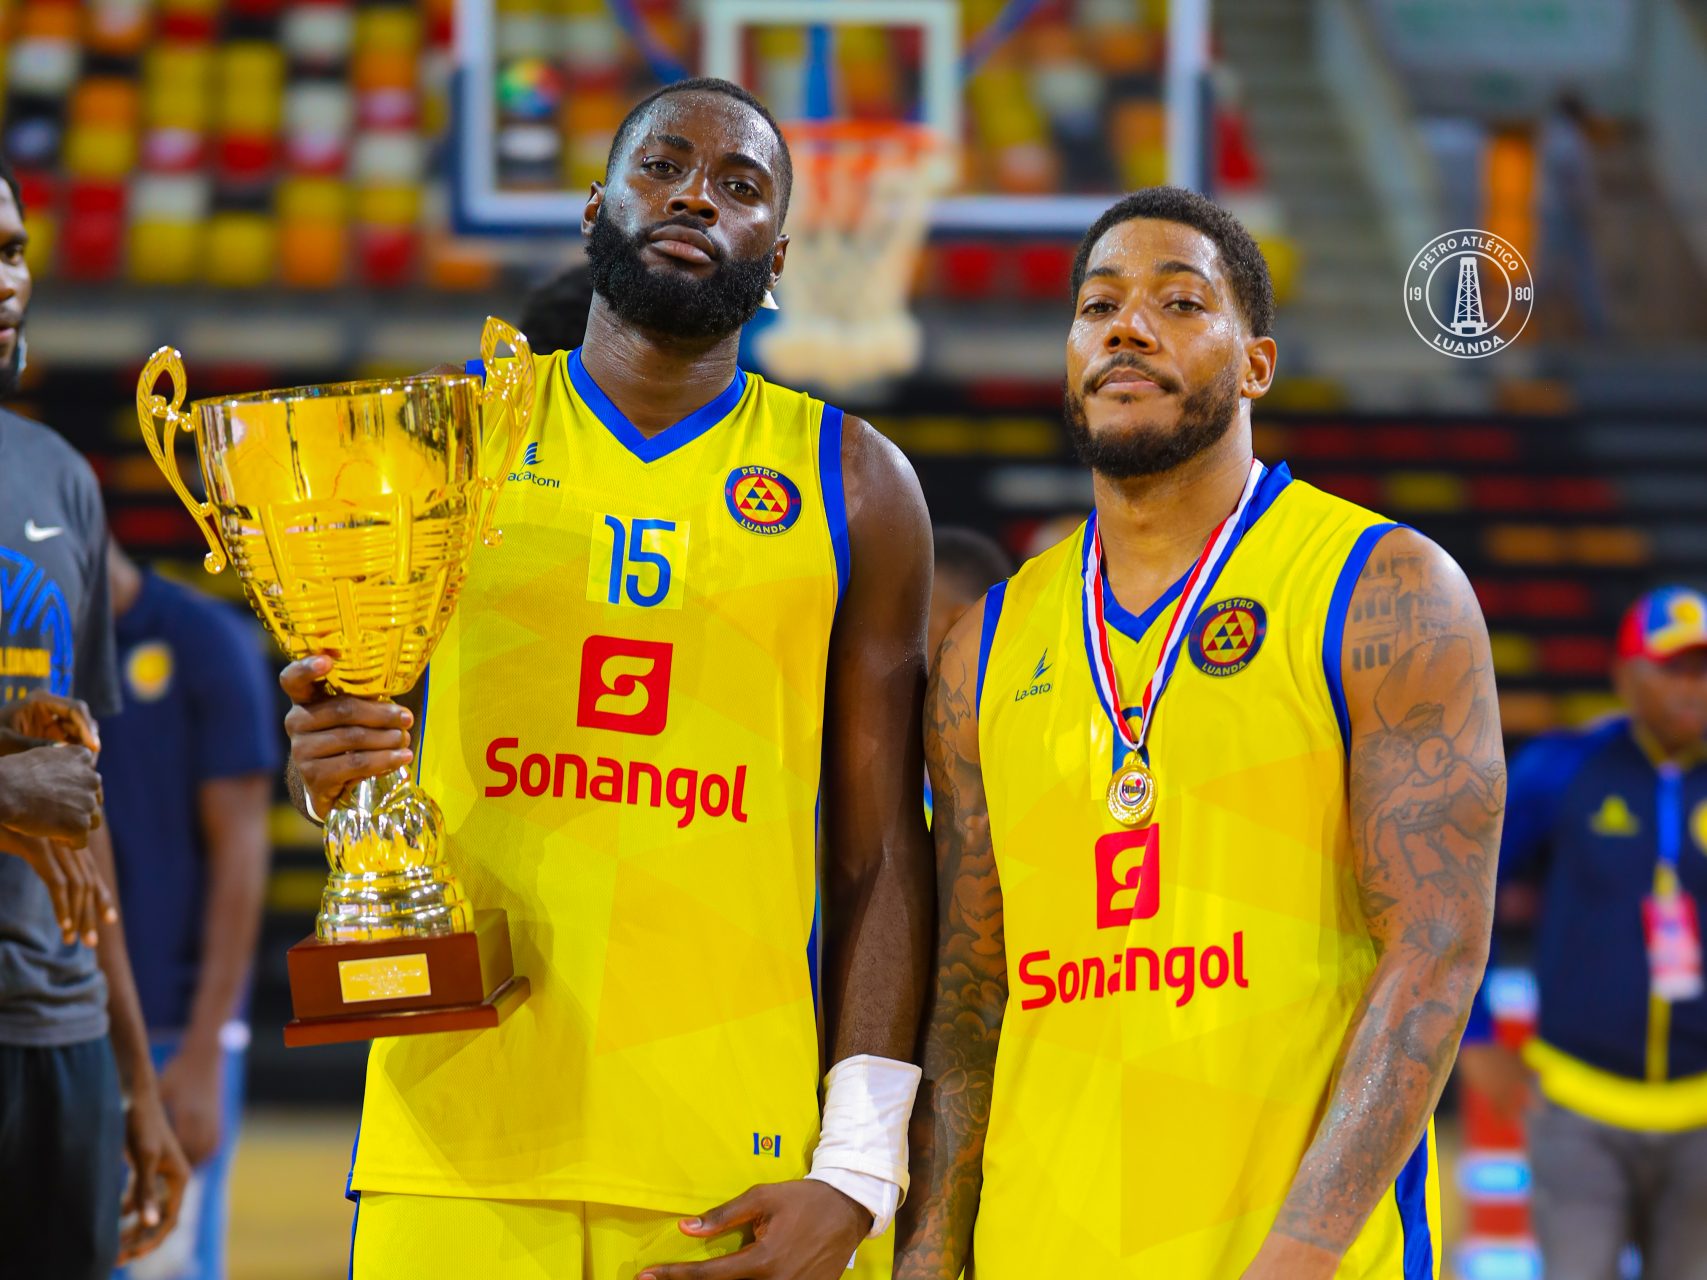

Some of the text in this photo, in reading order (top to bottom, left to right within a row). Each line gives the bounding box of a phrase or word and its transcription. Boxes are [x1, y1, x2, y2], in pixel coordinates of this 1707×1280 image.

[507, 471, 560, 488] acatoni
[741, 466, 779, 479] PETRO
[740, 518, 787, 534] LUANDA
[604, 514, 676, 607] 15
[1217, 599, 1254, 611] PETRO
[1201, 661, 1247, 675] LUANDA
[484, 737, 748, 829] Sonangol
